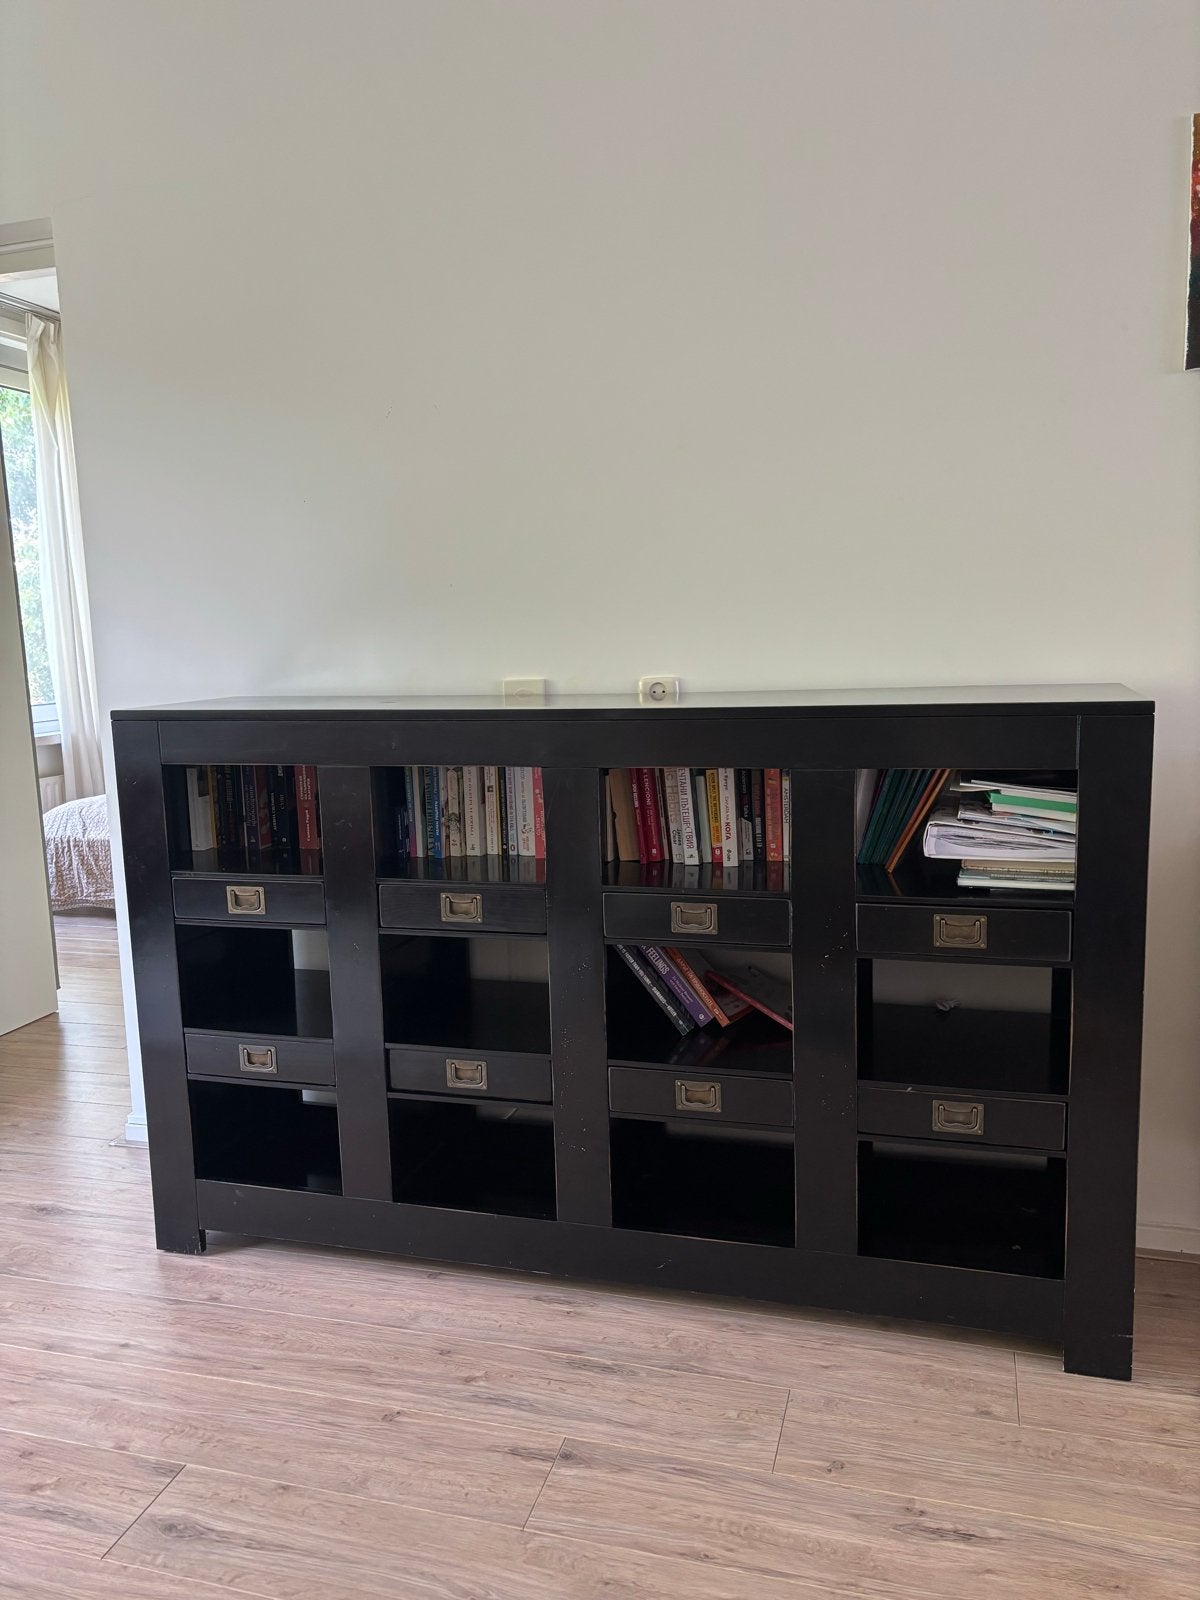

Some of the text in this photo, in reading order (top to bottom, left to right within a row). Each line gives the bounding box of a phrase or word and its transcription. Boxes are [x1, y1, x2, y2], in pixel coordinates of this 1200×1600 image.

[678, 768, 688, 796] ЕЧТАНИ
[667, 785, 679, 824] Habits
[646, 947, 670, 975] FEELINGS
